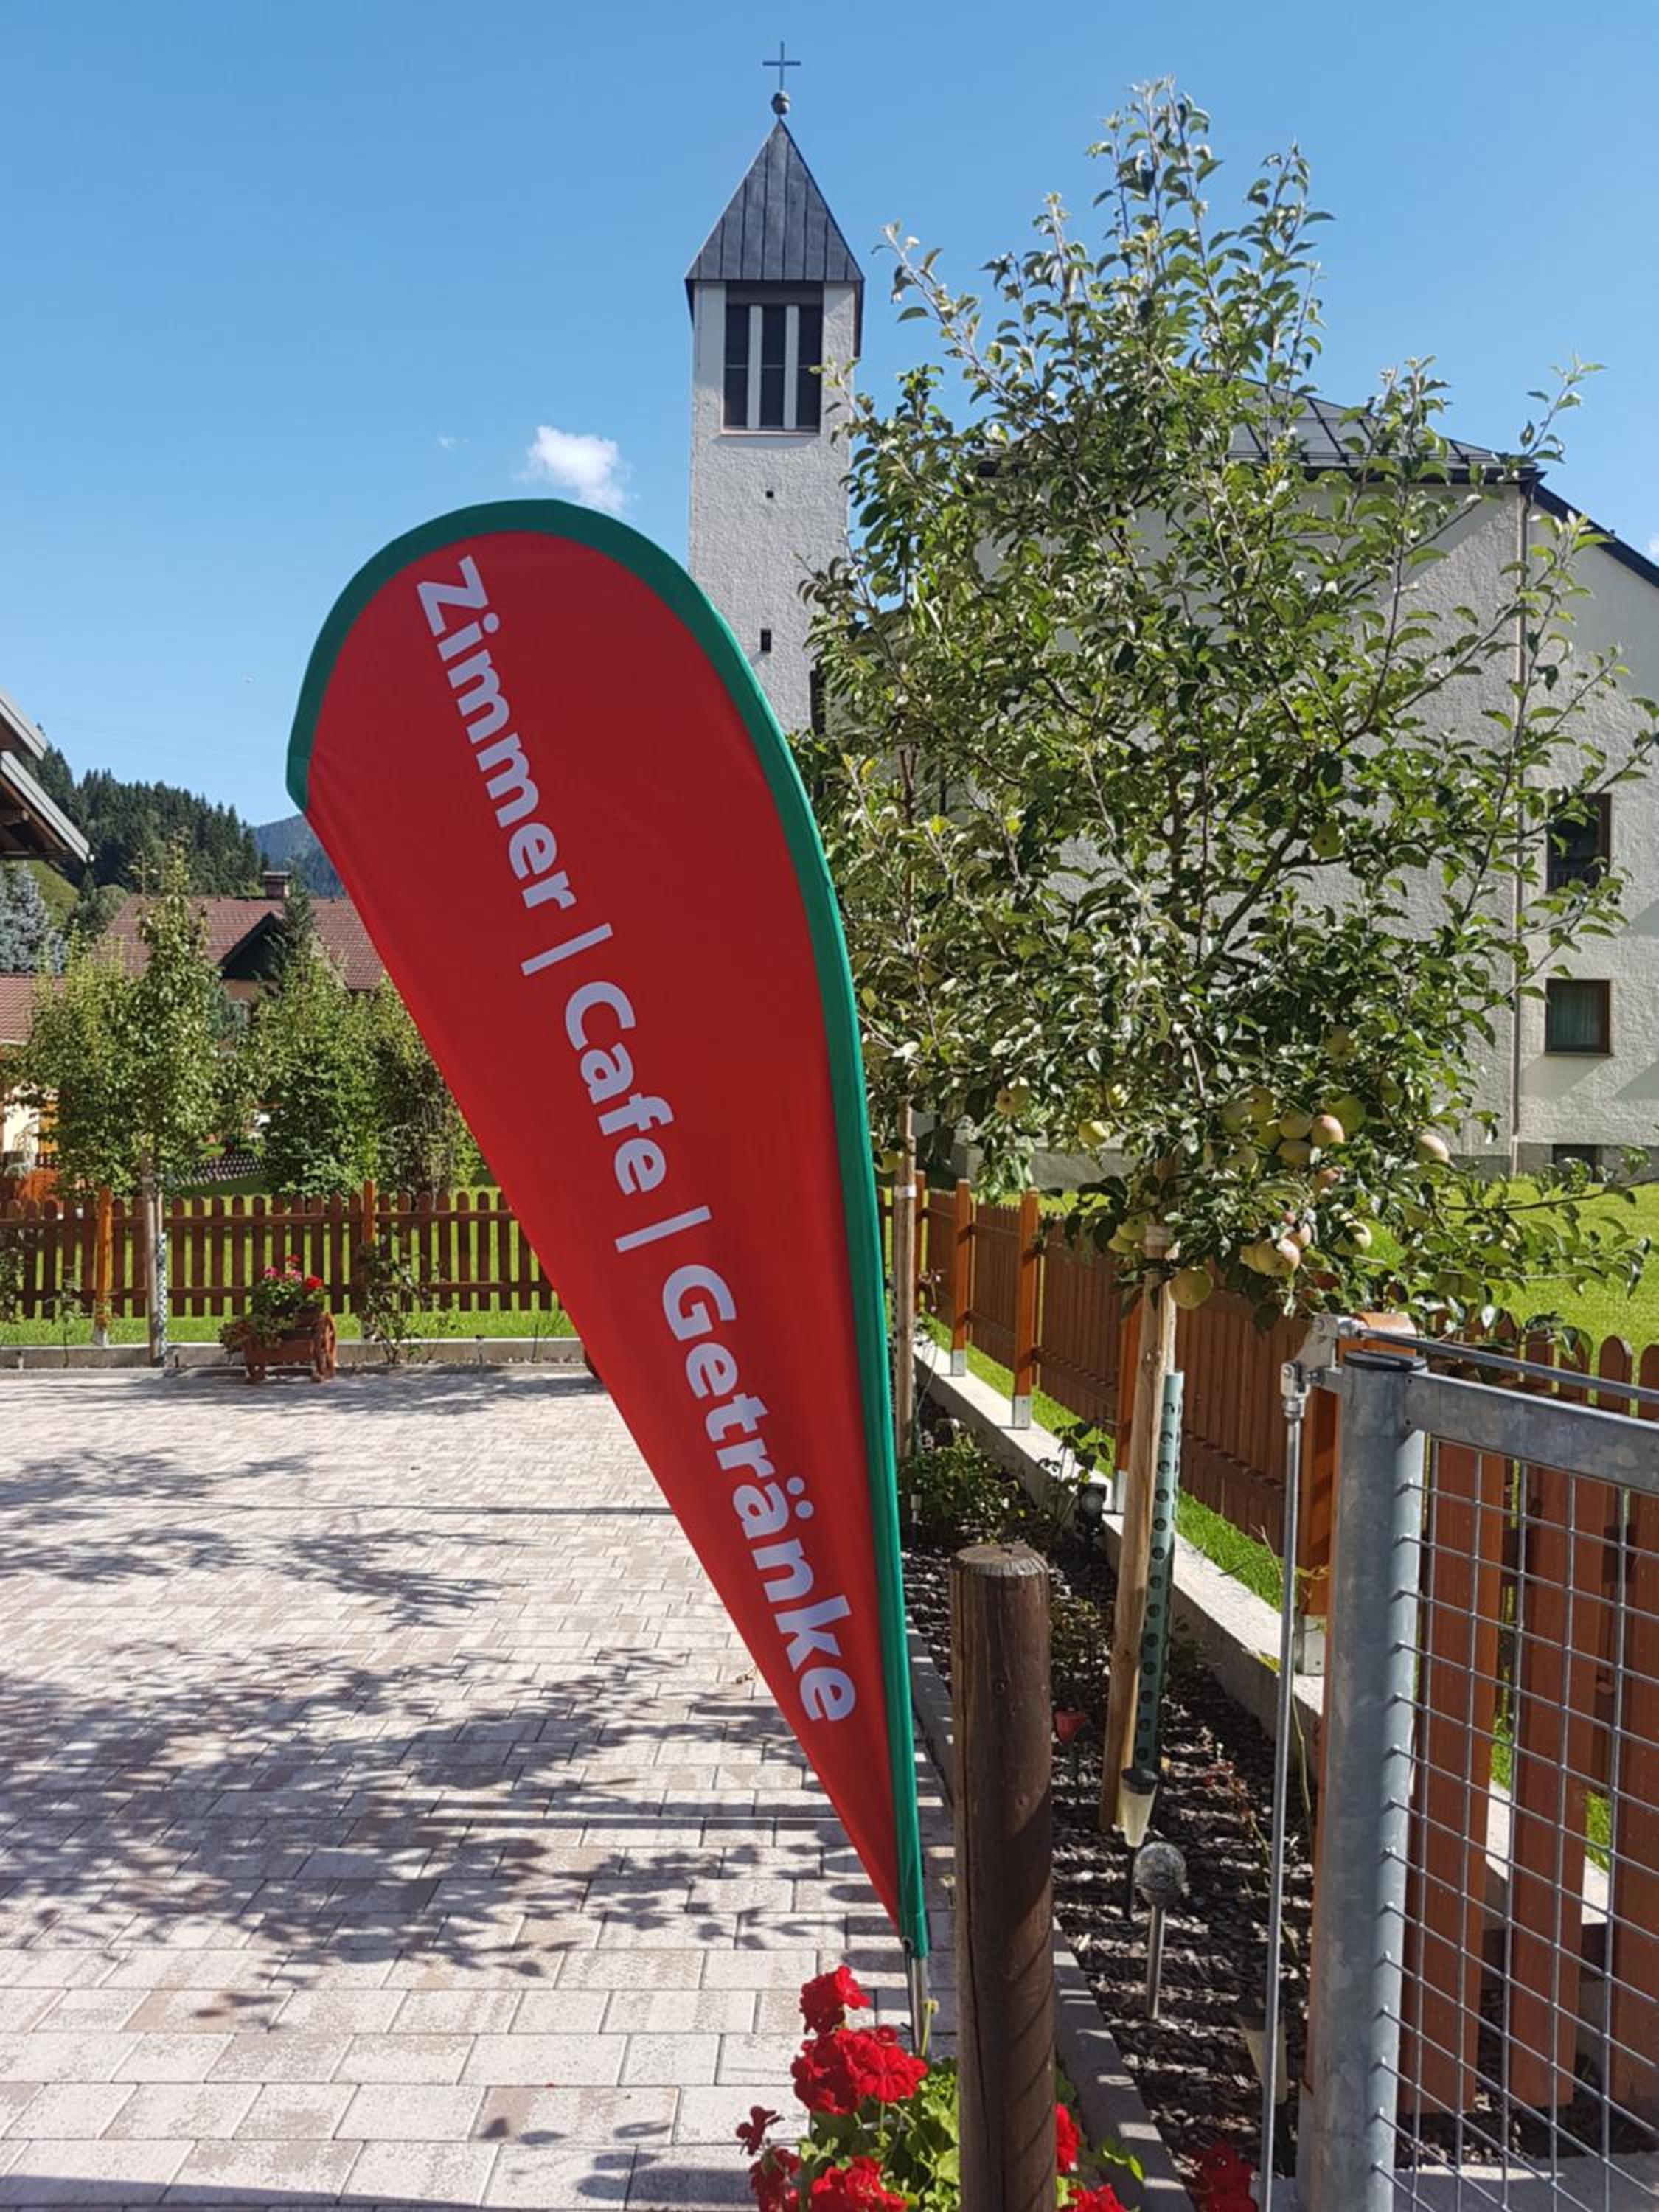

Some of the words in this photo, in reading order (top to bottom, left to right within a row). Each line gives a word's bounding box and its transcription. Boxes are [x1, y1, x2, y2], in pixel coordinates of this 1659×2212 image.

[416, 554, 577, 910] Zimmer
[565, 981, 674, 1196] Cafe
[662, 1264, 855, 1722] Getränke
